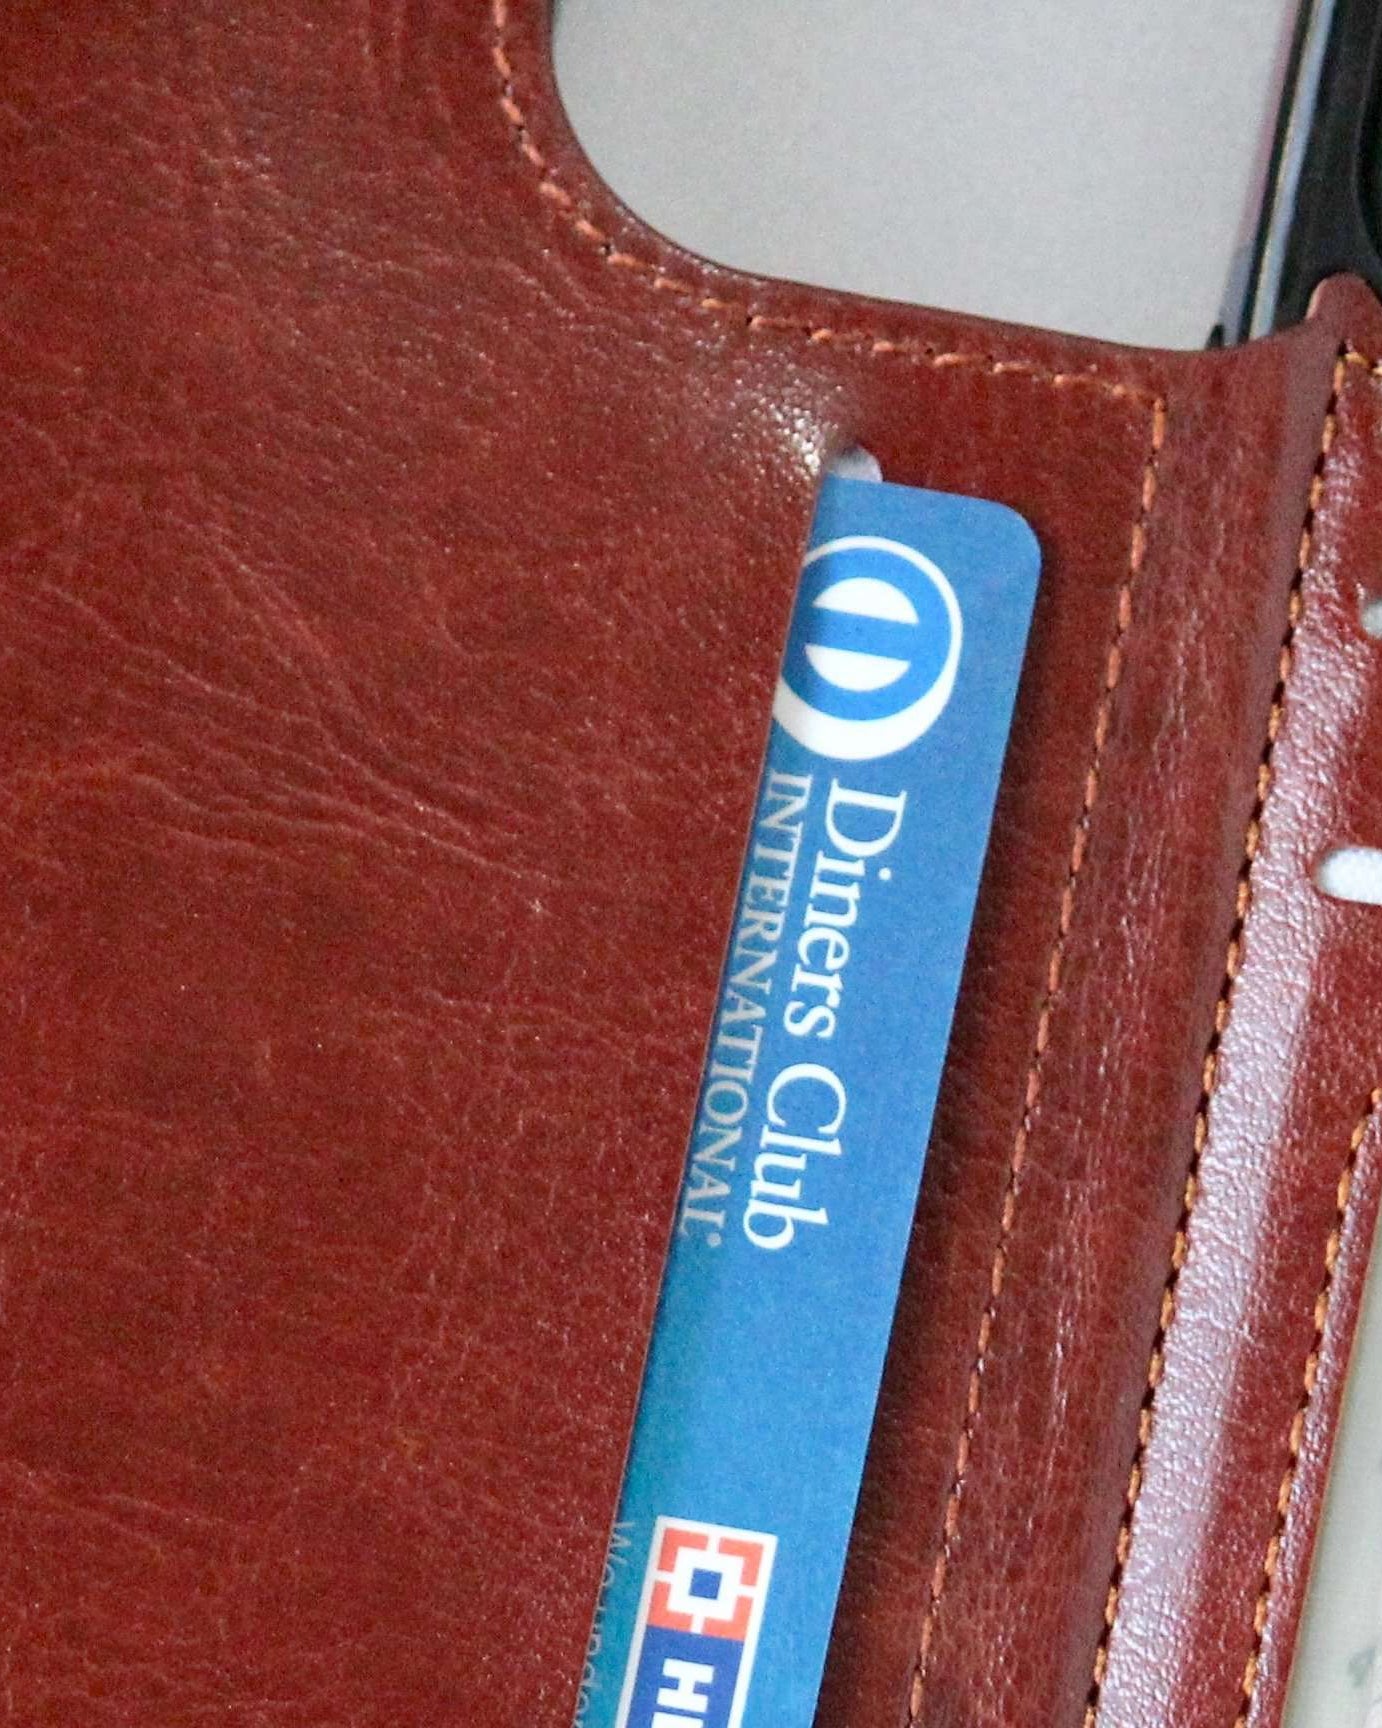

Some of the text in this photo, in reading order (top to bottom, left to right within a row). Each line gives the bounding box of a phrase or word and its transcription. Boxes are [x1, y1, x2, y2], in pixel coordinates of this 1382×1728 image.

[679, 770, 813, 1238] INTERNATIONAL
[742, 777, 908, 1251] Diners Club
